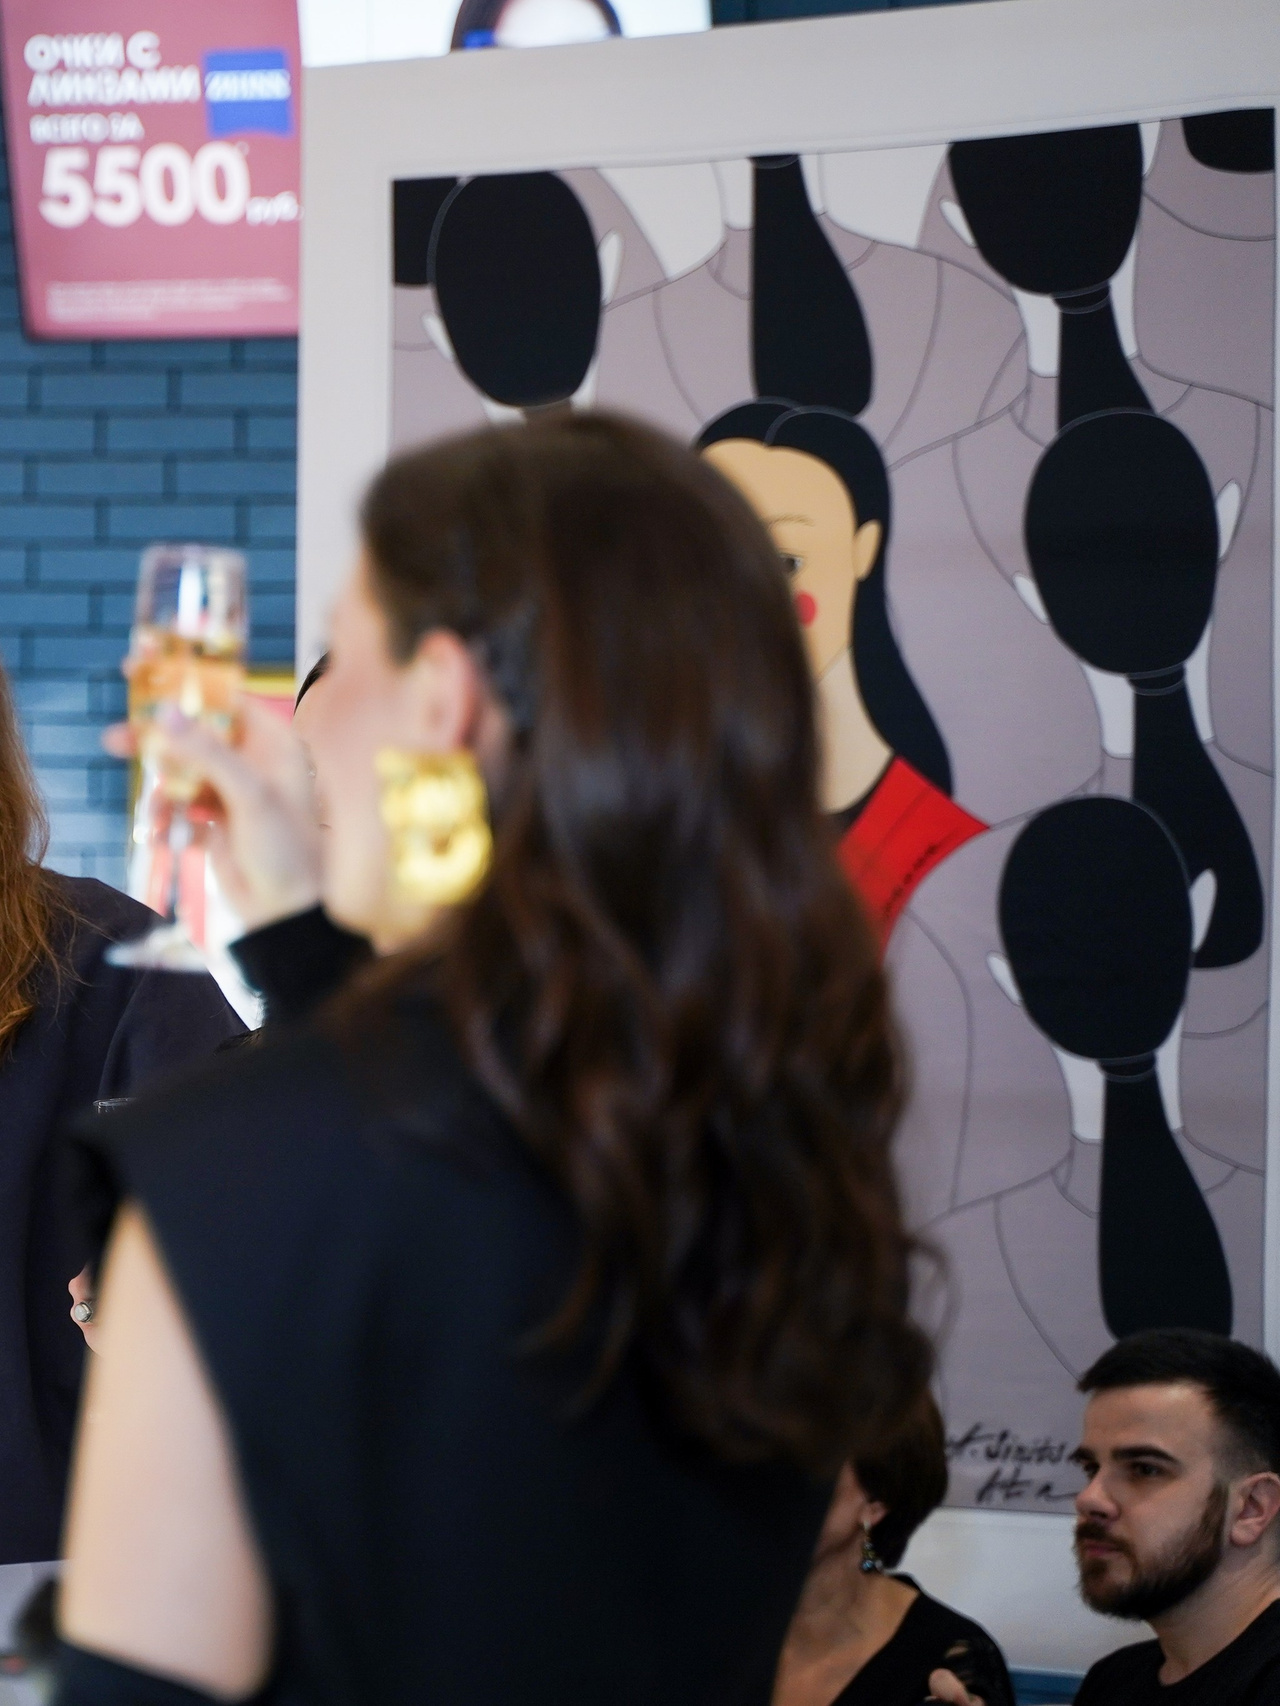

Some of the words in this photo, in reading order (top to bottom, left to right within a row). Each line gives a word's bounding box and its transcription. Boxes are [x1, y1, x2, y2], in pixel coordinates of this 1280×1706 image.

[24, 33, 124, 72] ОЧКИ
[126, 30, 162, 70] С
[28, 66, 201, 106] ЛИНЗАМИ
[39, 142, 250, 228] 5500
